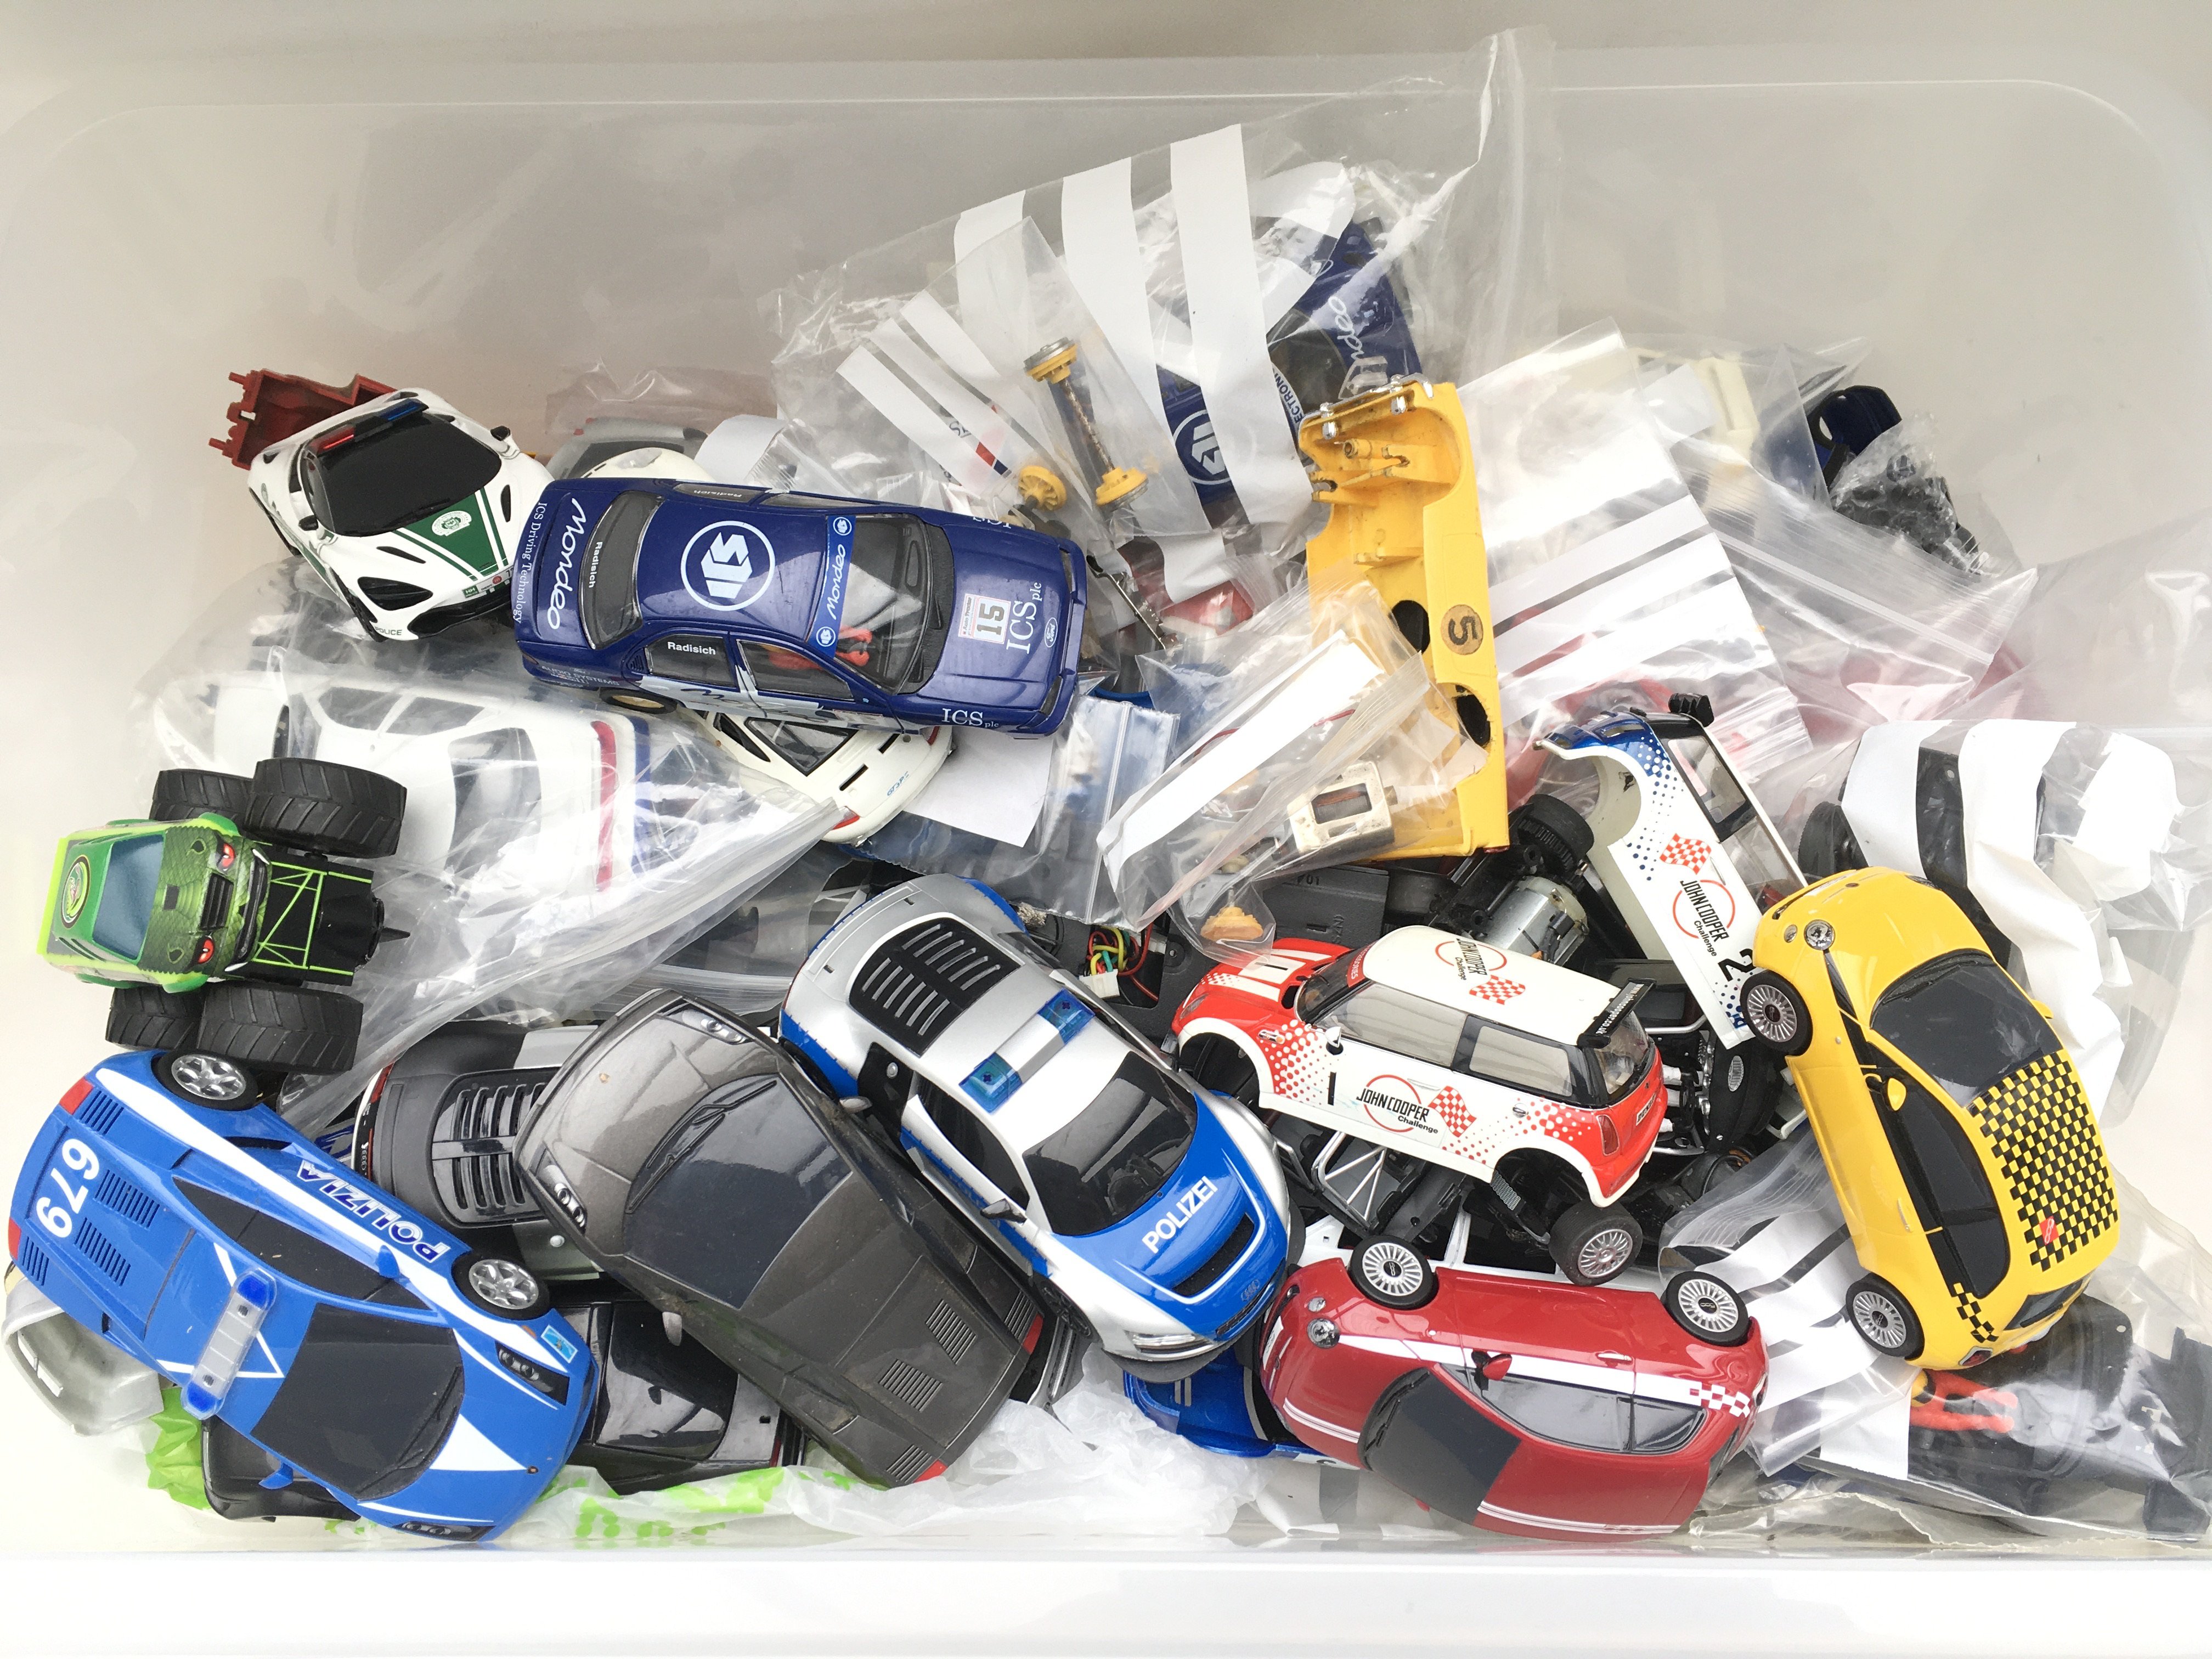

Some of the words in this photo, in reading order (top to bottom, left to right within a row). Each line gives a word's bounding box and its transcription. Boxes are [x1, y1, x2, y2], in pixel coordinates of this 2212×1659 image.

[533, 502, 547, 520] ICS
[693, 490, 742, 498] Radisich
[522, 522, 541, 560] Driving
[547, 498, 586, 629] Mondeo
[589, 541, 603, 588] Radisich
[827, 544, 846, 620] Mondeo
[513, 561, 532, 624] Technology
[1030, 582, 1042, 602] plc
[375, 626, 402, 635] POLICE
[977, 603, 1005, 635] 15
[1006, 600, 1037, 654] ICS
[1448, 616, 1478, 646] 5
[667, 641, 716, 655] Radisich
[941, 708, 983, 726] ICS
[1694, 920, 1717, 957] Challenge
[1455, 957, 1467, 980] Challenge
[1596, 984, 1645, 1035] www.johncooper.co.uk
[1398, 1115, 1438, 1133] Challenge
[36, 1138, 99, 1238] 679
[297, 1159, 451, 1263] POLIZIA
[1142, 1176, 1218, 1254] POLIZEI
